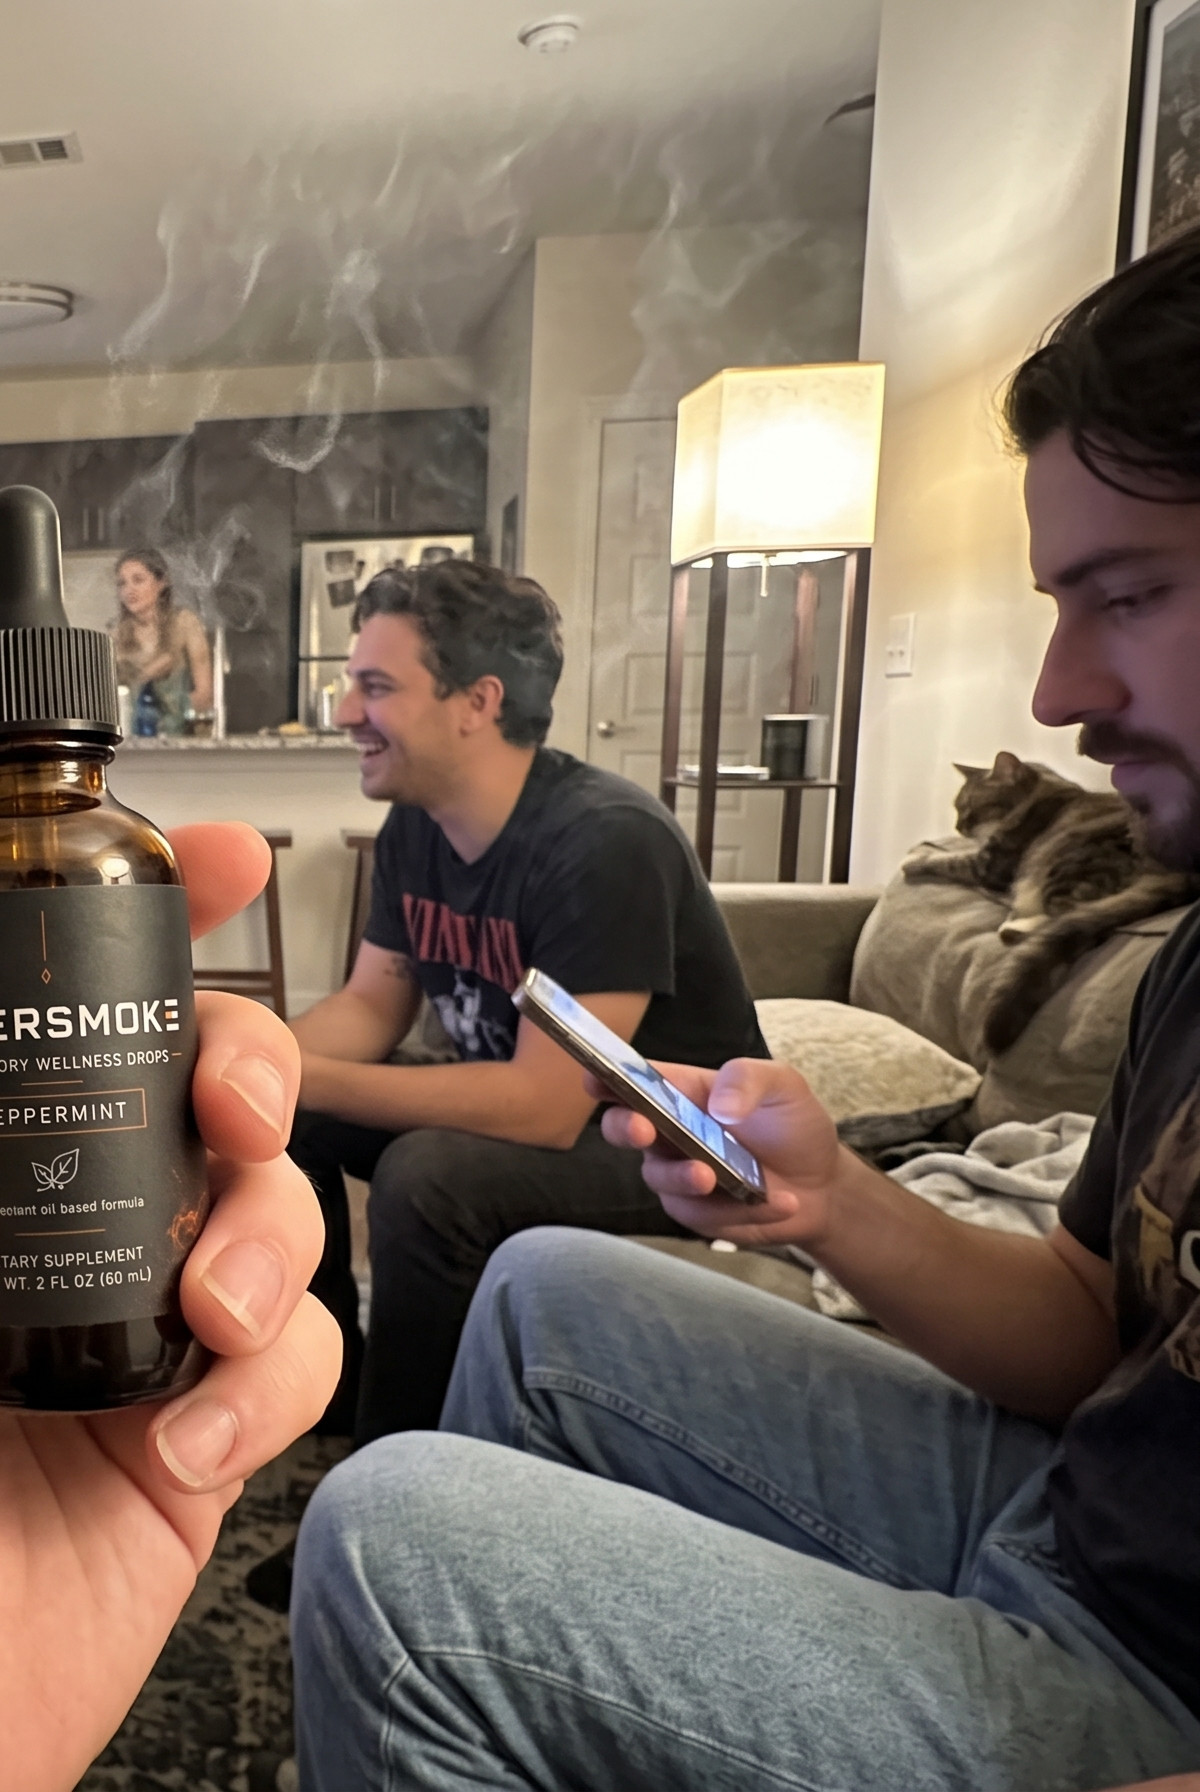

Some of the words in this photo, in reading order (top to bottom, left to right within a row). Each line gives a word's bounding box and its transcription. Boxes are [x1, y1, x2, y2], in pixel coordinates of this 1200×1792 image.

[36, 1052, 122, 1072] WELLNESS
[127, 1049, 169, 1066] DROPS
[40, 1203, 56, 1215] oil
[60, 1201, 97, 1214] based
[101, 1196, 145, 1211] formula
[44, 1246, 144, 1268] SUPPLEMENT
[3, 1276, 31, 1290] WT.
[36, 1276, 45, 1290] 2
[51, 1275, 69, 1289] FL
[74, 1273, 94, 1288] OZ
[100, 1271, 123, 1287] (60
[128, 1266, 152, 1283] mL)
